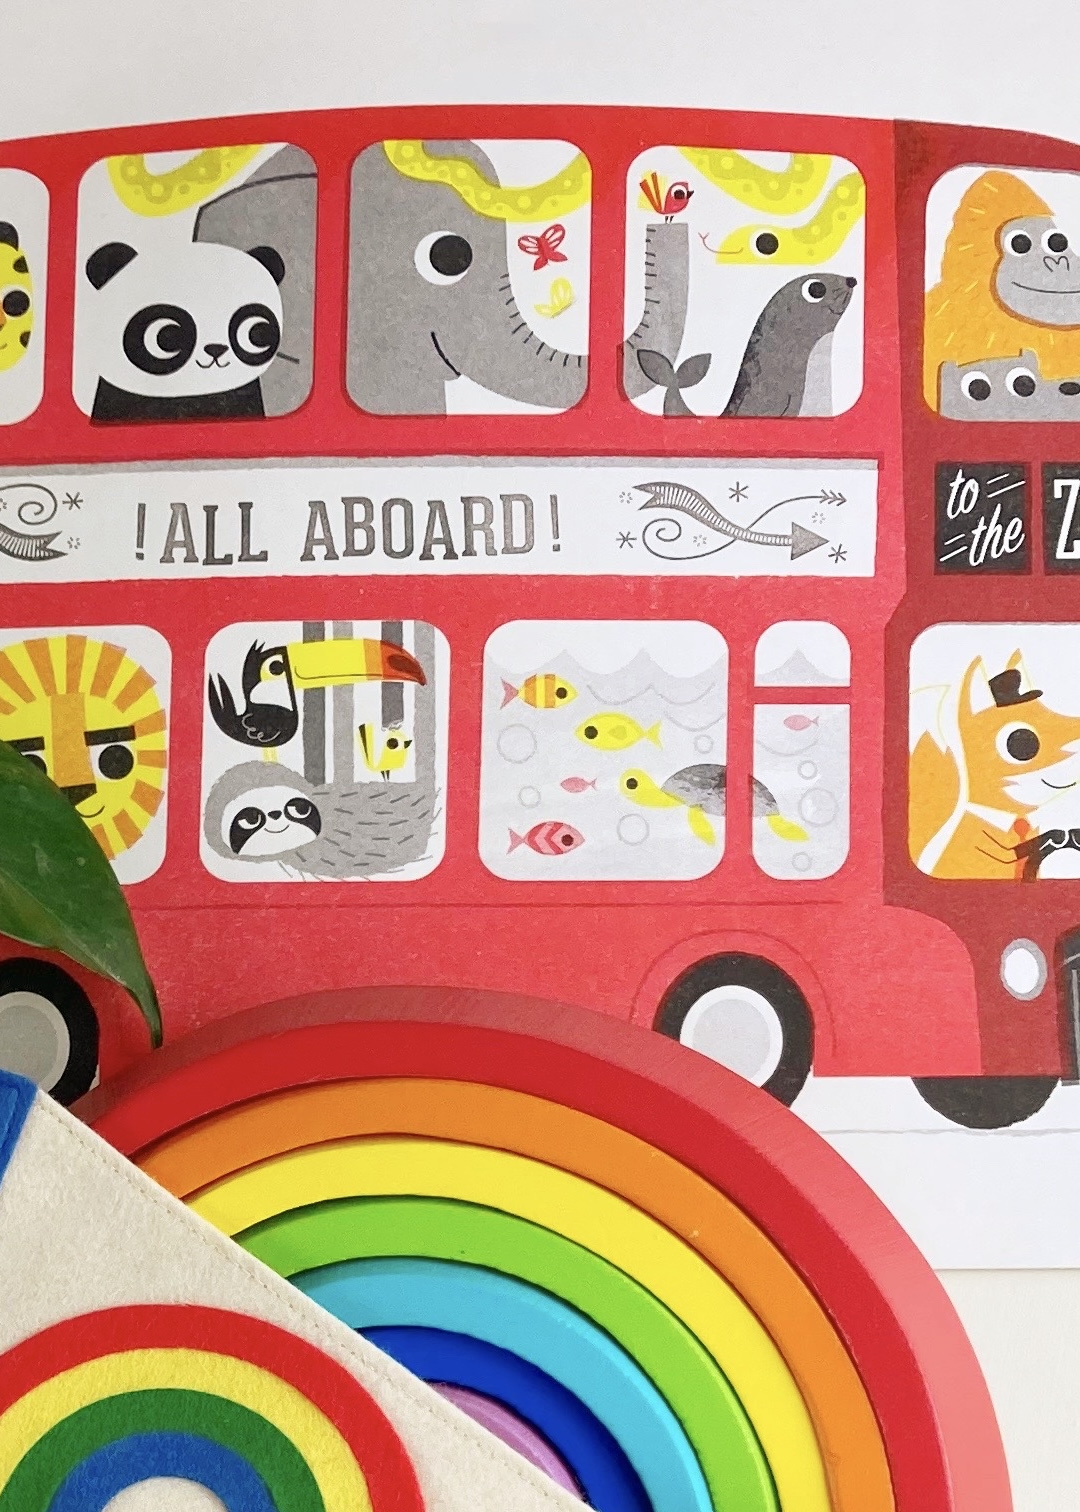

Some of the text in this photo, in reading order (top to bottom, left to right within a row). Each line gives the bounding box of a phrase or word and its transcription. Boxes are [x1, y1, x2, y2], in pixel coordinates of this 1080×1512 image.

[946, 468, 980, 520] to
[134, 493, 561, 567] !ALL ABOARD!
[968, 503, 1026, 567] the
